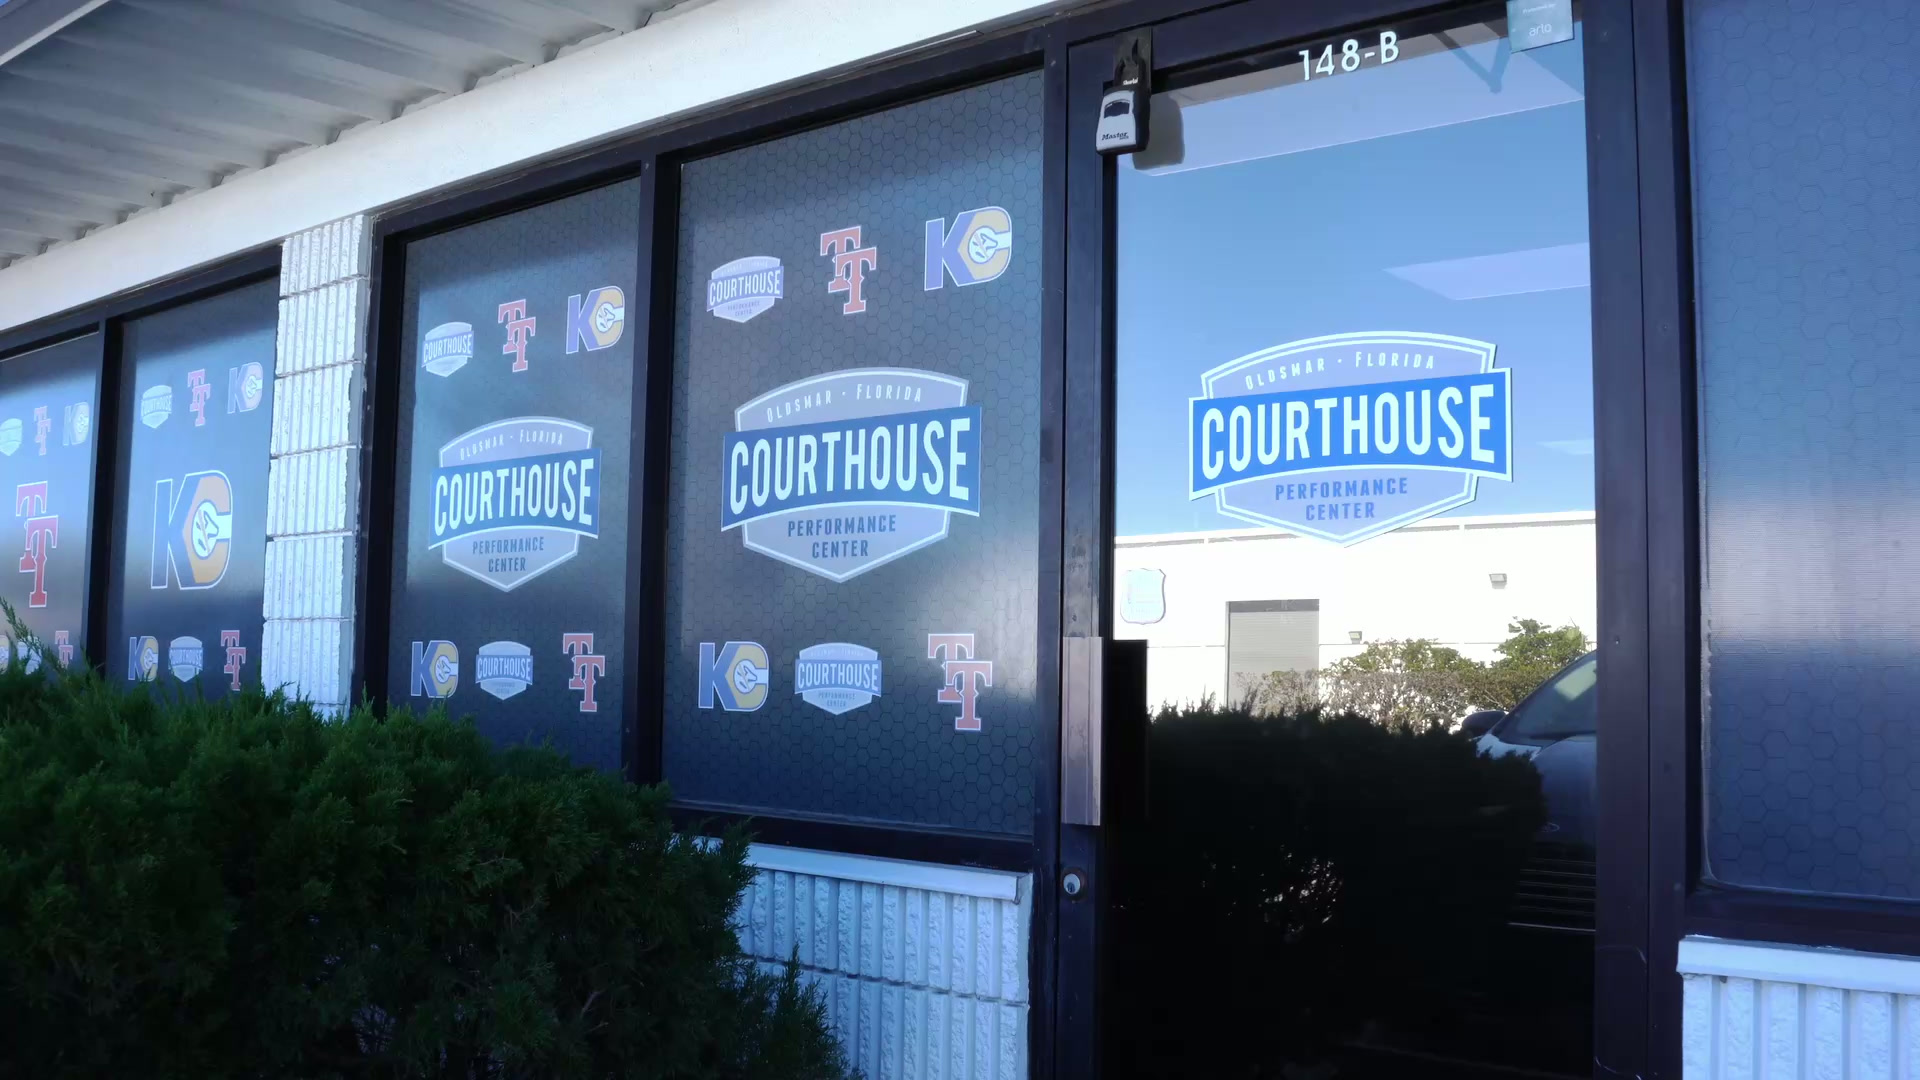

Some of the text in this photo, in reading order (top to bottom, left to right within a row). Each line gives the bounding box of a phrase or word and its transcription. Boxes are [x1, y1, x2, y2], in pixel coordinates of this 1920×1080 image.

[1299, 31, 1399, 81] 148-B
[709, 269, 781, 306] COURTHOUSE
[423, 333, 473, 363] COURTHOUSE
[1245, 351, 1434, 390] OLDSMAR FLORIDA
[767, 383, 922, 423] OLDSMAR FLORIDA
[460, 429, 563, 460] OLDSMAR FLORIDA
[1202, 383, 1495, 480] COURTHOUSE
[730, 417, 971, 515] COURTHOUSE
[434, 458, 594, 536] COURTHOUSE
[1275, 477, 1408, 501] PERFORMANCE
[788, 514, 896, 537] PERFORMANCE
[1305, 502, 1375, 521] CENTER
[472, 536, 544, 555] PERFORMANCE
[812, 539, 869, 559] CENTER
[488, 557, 526, 573] CENTER
[477, 657, 532, 681] COURTHOUSE
[798, 662, 879, 692] COURTHOUSE
